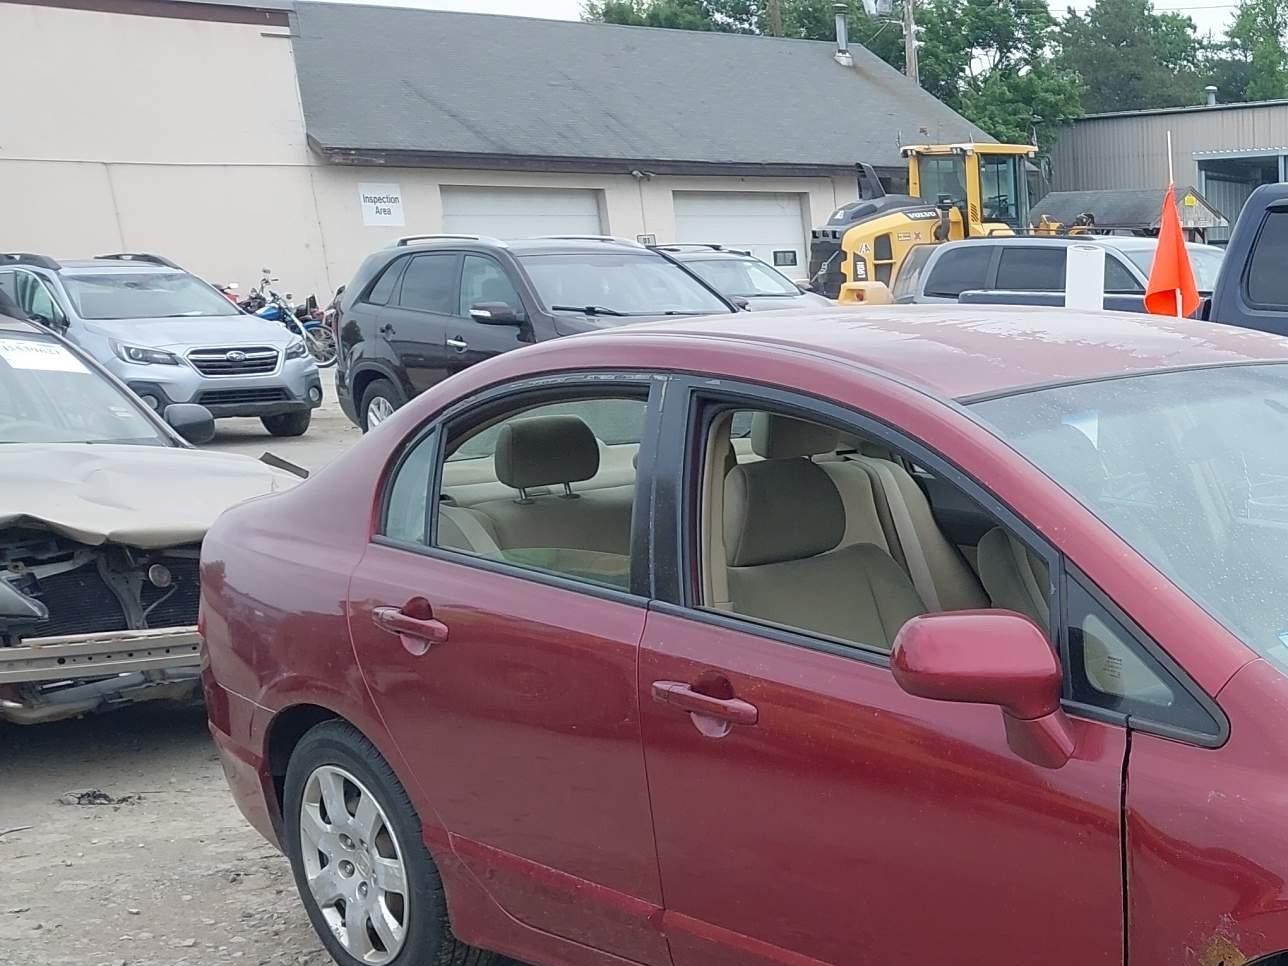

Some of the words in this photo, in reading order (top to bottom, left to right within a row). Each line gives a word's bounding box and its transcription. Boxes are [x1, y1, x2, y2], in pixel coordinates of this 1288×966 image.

[362, 193, 400, 205] Inspection
[375, 205, 392, 215] Area
[907, 211, 936, 219] VOLVO
